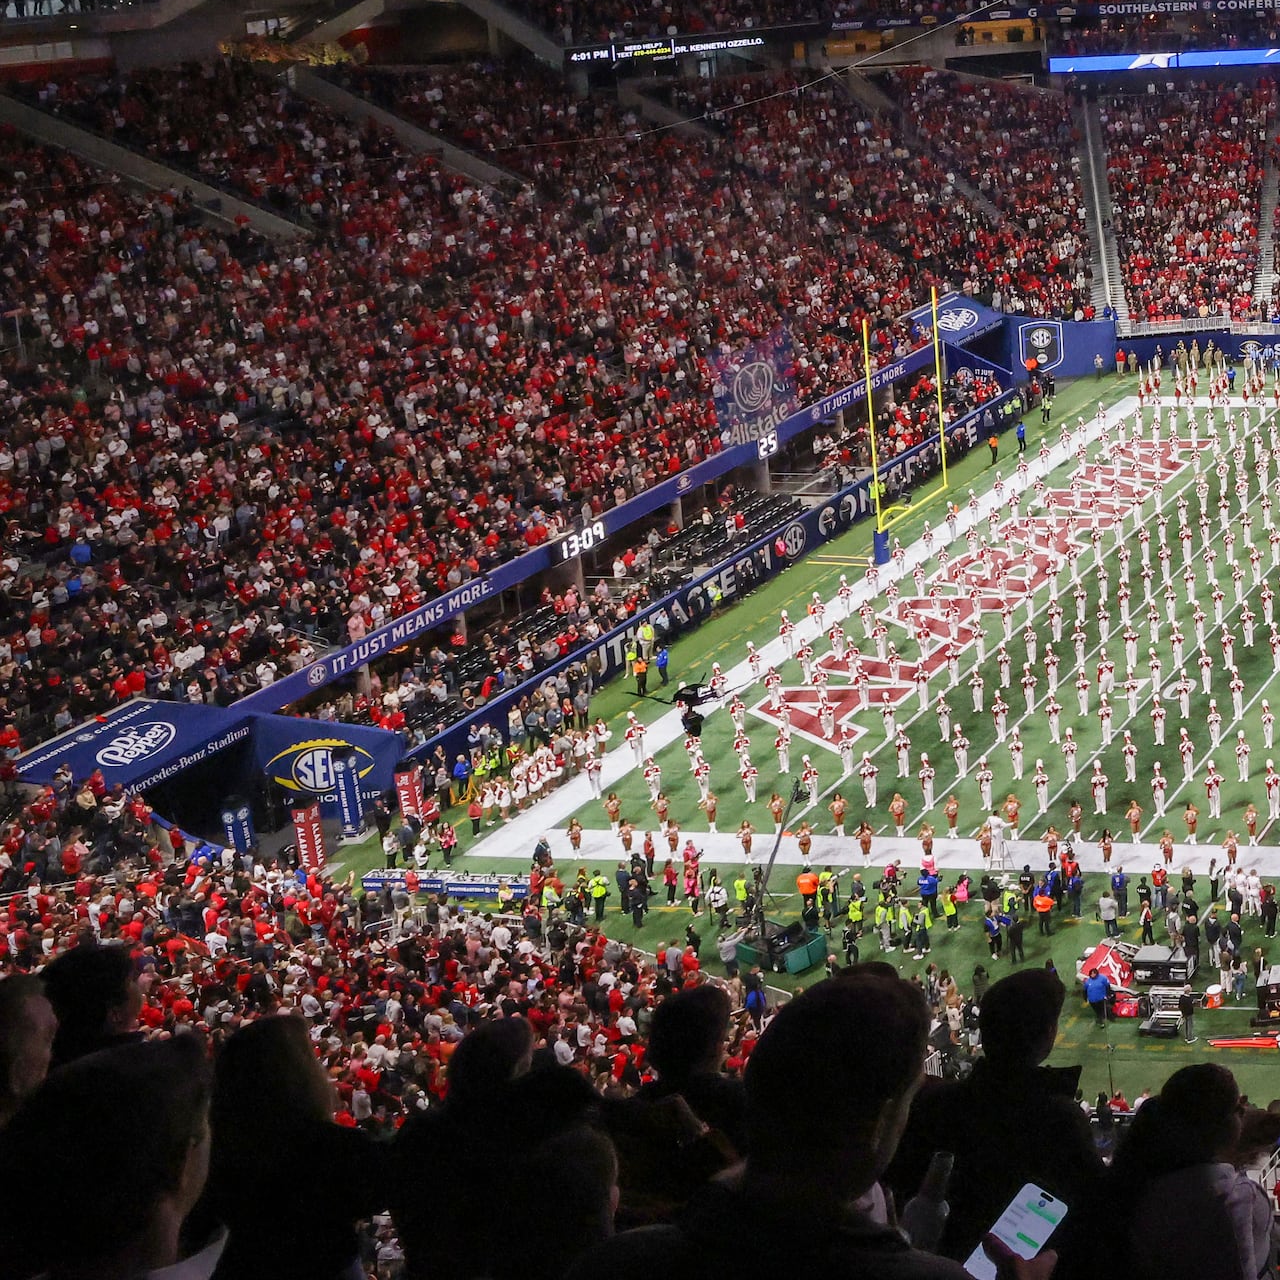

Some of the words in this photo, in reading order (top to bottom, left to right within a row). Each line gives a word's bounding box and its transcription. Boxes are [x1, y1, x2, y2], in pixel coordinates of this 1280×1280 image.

[1099, 2, 1198, 15] SOUTHEASTERN
[570, 51, 592, 61] 4:01
[593, 49, 609, 60] PM
[617, 51, 633, 59] TEXT
[690, 42, 726, 52] KENNETH
[1031, 330, 1051, 347] SEC
[823, 402, 832, 414] IT
[832, 392, 852, 411] JUST
[853, 376, 881, 399] MENS
[730, 402, 789, 446] Allstate
[758, 433, 777, 458] 25
[561, 521, 606, 560] 13:09
[748, 438, 1213, 753] ALABAMA
[332, 654, 348, 675] IT
[349, 632, 390, 667] JUST
[392, 603, 445, 643] MEANS
[94, 703, 153, 735] CONFERENCE
[97, 723, 165, 766] Pepper
[123, 747, 207, 798] Mercedes-Benz
[207, 725, 250, 754] Stadium
[296, 750, 336, 789] SE
